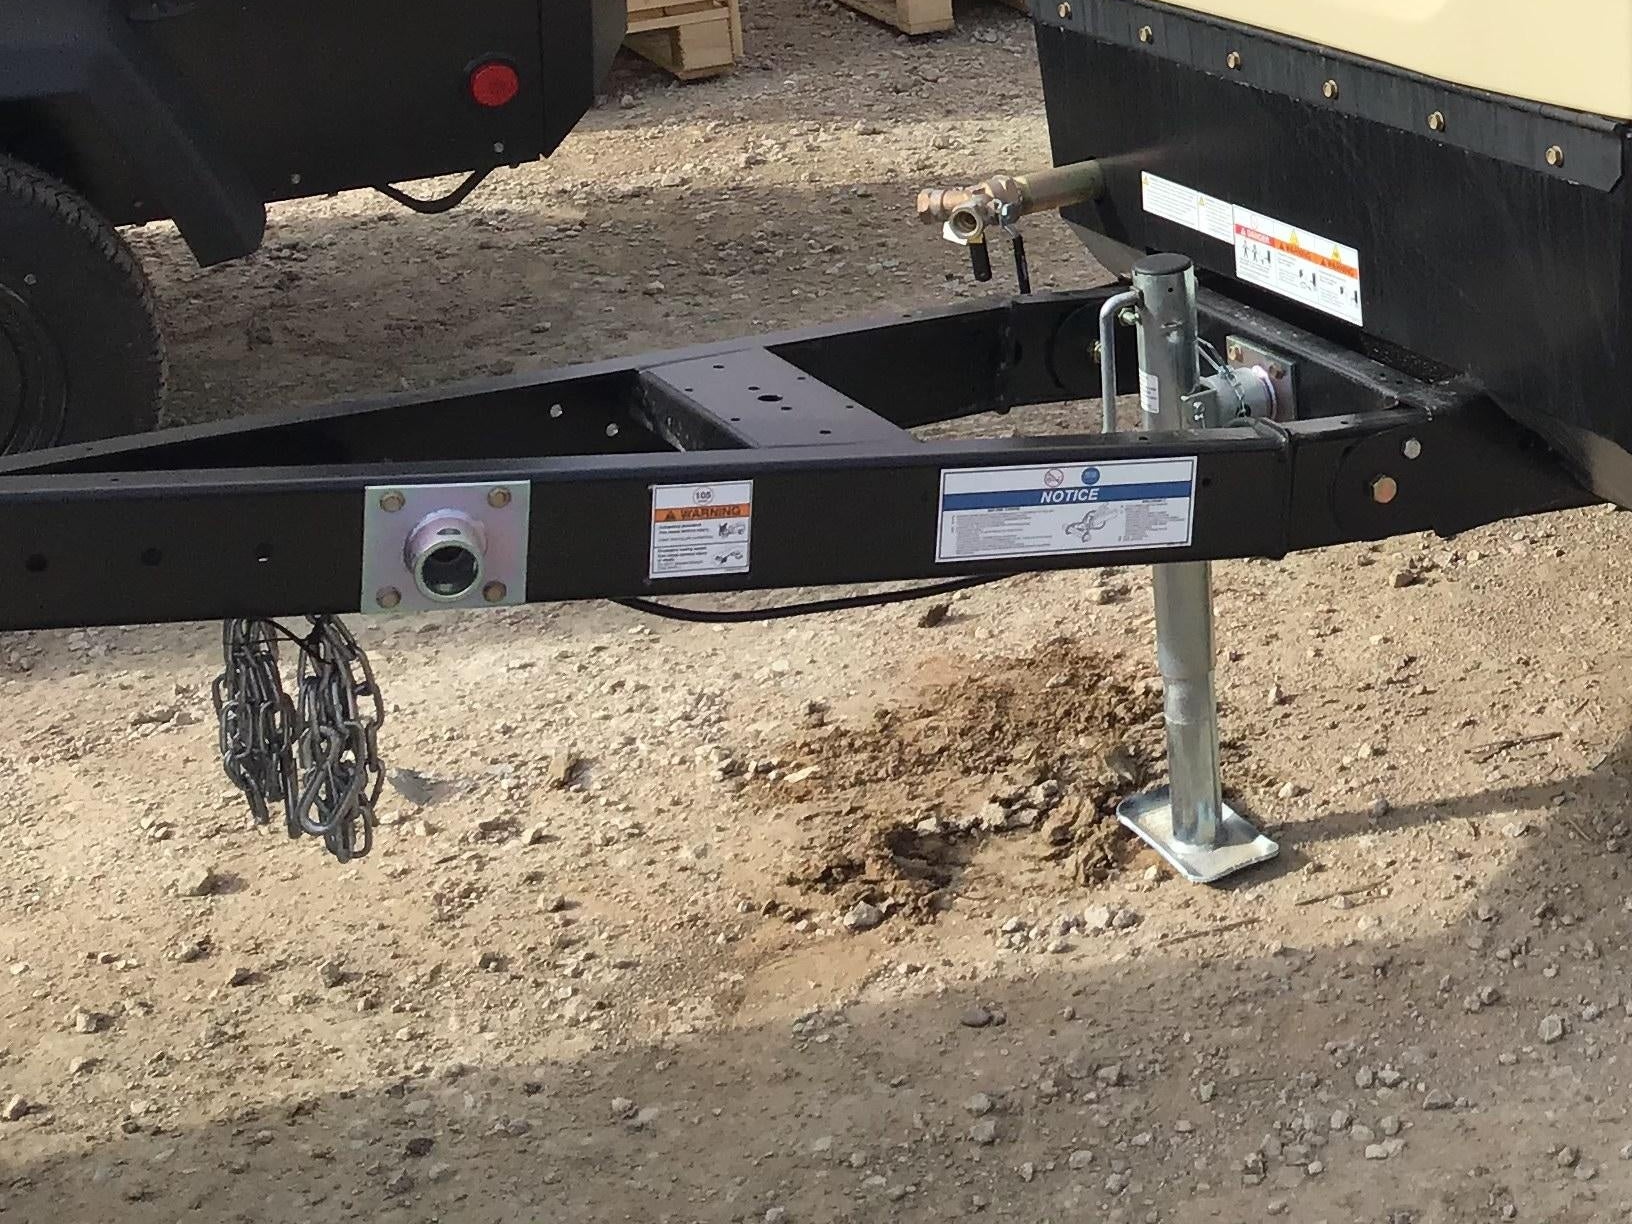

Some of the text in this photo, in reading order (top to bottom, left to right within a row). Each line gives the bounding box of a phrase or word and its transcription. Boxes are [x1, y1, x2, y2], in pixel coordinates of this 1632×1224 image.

[695, 491, 712, 499] 105
[1040, 487, 1100, 504] NOTICE
[680, 507, 741, 519] WARNING
